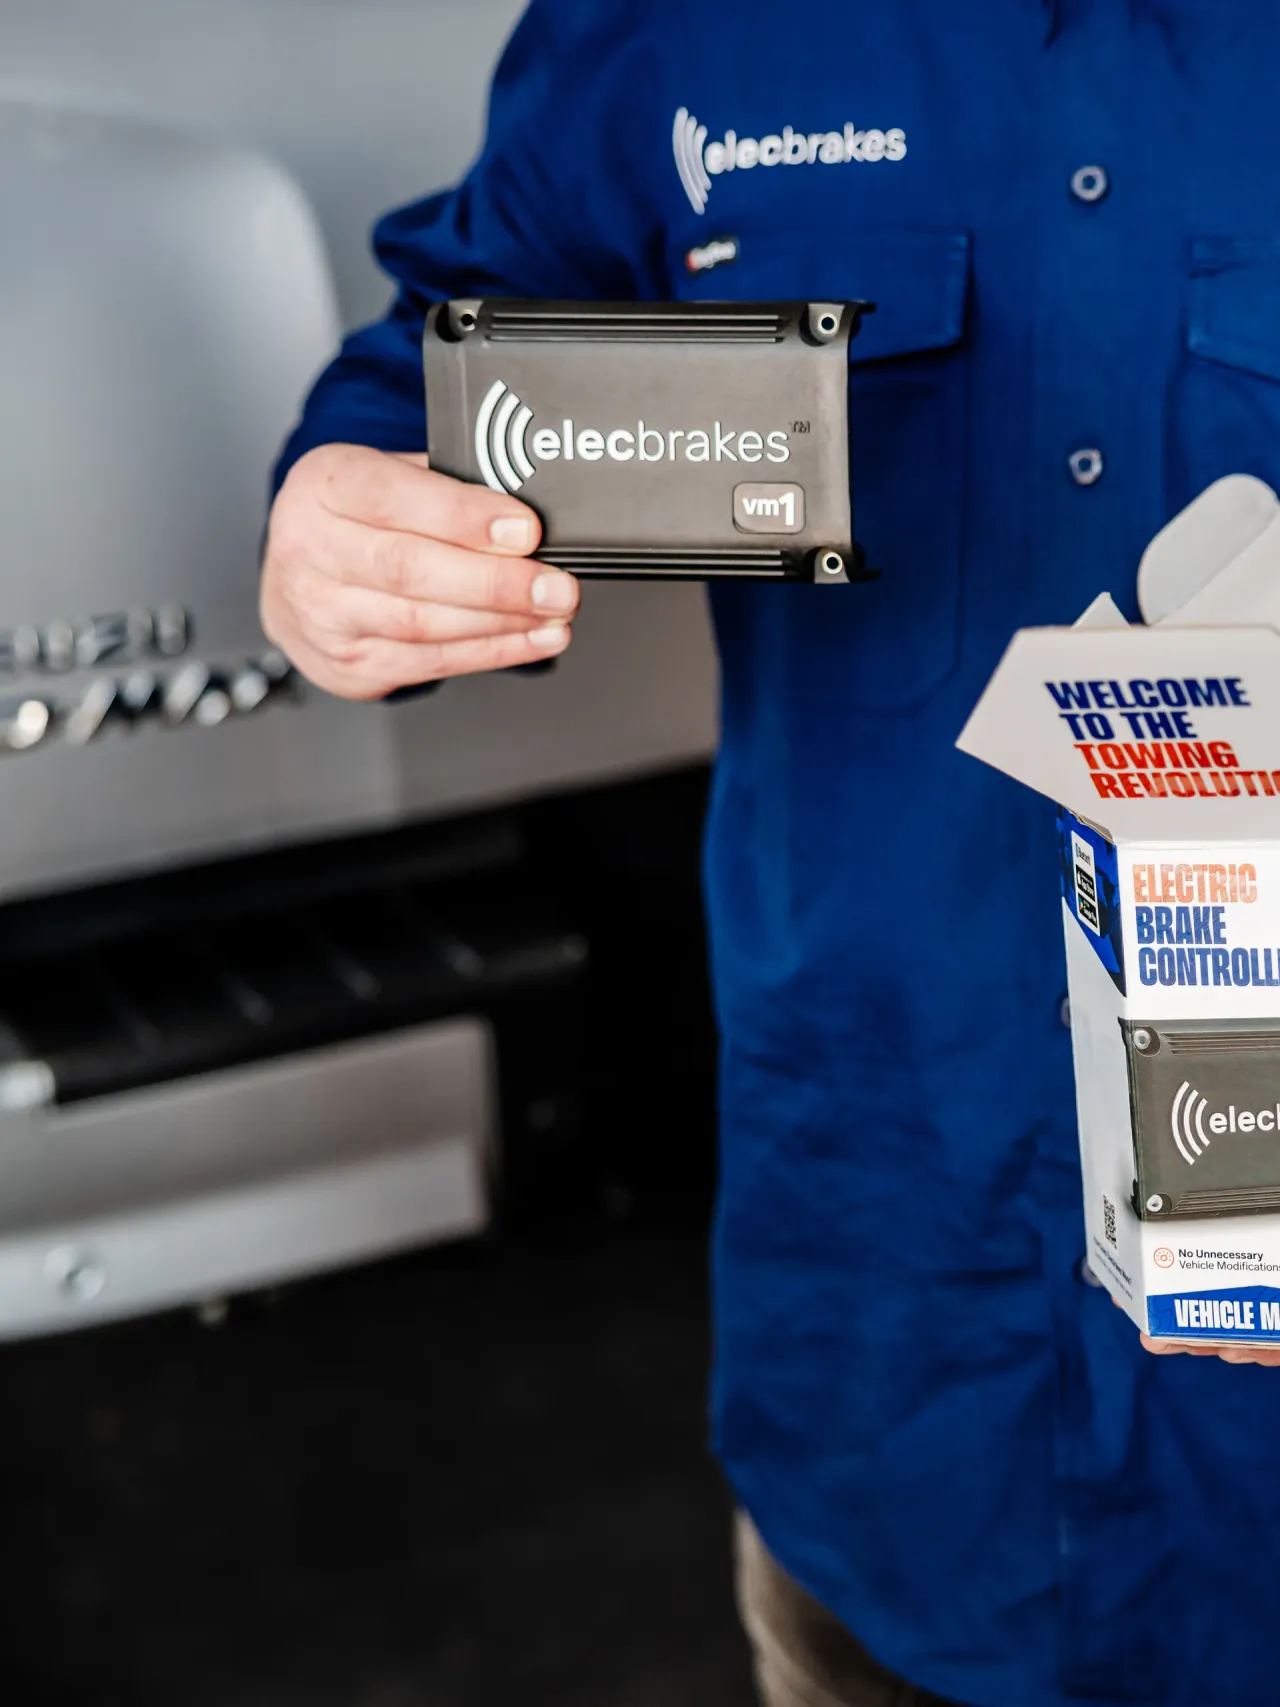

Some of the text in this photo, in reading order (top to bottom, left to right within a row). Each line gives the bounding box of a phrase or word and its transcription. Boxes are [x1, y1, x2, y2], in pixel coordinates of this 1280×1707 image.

[704, 121, 908, 174] elecbrakes
[532, 419, 791, 462] elecbrakes
[742, 492, 795, 526] vm1
[1044, 678, 1252, 710] WELCOME
[1059, 711, 1198, 741] TO THE
[1074, 741, 1240, 770] TOWING
[1132, 863, 1258, 904] ELECTRIC
[1135, 906, 1227, 945] BRAKE
[1178, 1249, 1264, 1262] No Unnecessary
[1179, 1260, 1215, 1271] Vehicle
[1174, 1299, 1255, 1330] VEHICLE
